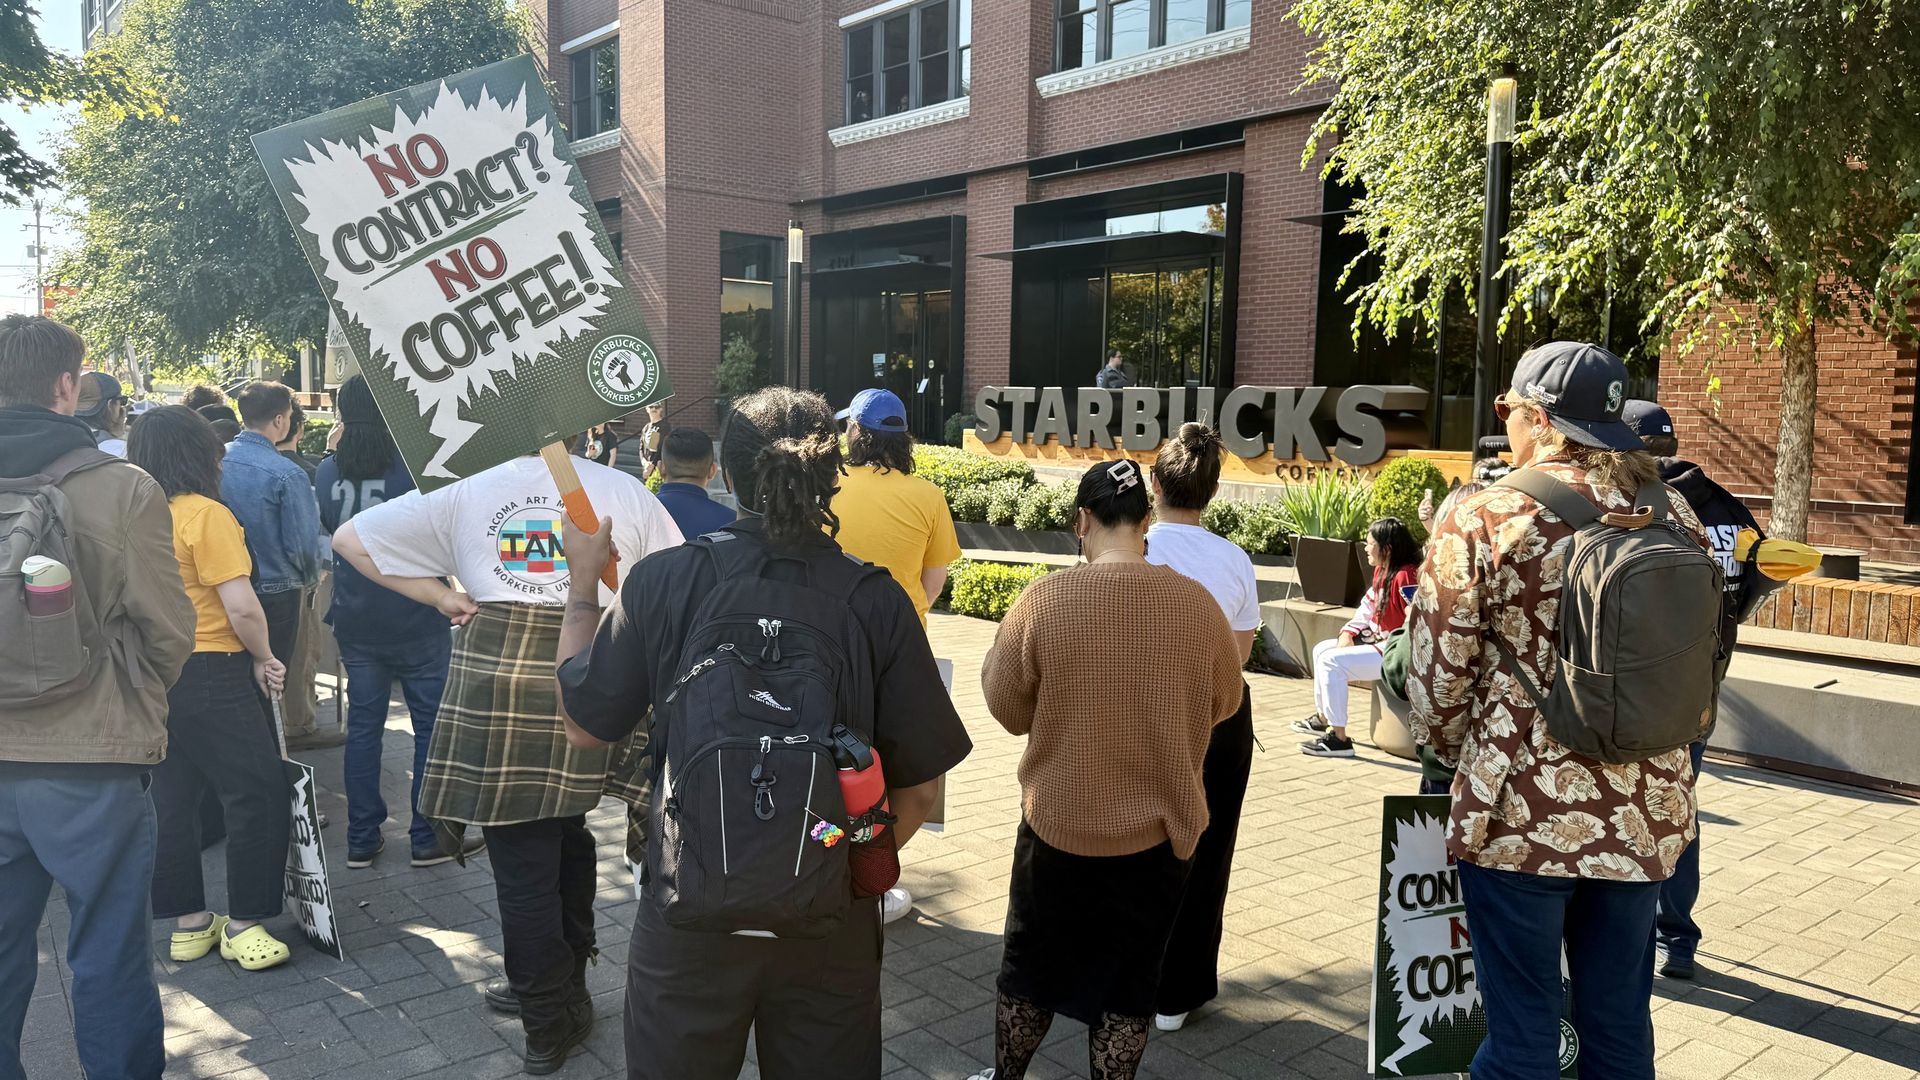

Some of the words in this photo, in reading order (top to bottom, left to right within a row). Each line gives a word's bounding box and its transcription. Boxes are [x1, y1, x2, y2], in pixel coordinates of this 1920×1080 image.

[363, 133, 448, 198] NO
[332, 131, 550, 275] CONTRACT?
[426, 236, 508, 302] NO
[401, 230, 600, 383] COFFEE!
[592, 338, 642, 367] STARBUCKS
[595, 378, 636, 402] WORKERS
[641, 359, 655, 392] UNITED
[975, 384, 1389, 466] STARBUCKS
[1485, 441, 1505, 449] DEITY
[331, 479, 386, 526] 25
[486, 501, 519, 538] TACOMA
[526, 496, 549, 505] ART
[1706, 524, 1743, 551] ASH
[493, 565, 544, 595] WORKERS
[299, 903, 317, 927] NO
[1449, 916, 1472, 949] N
